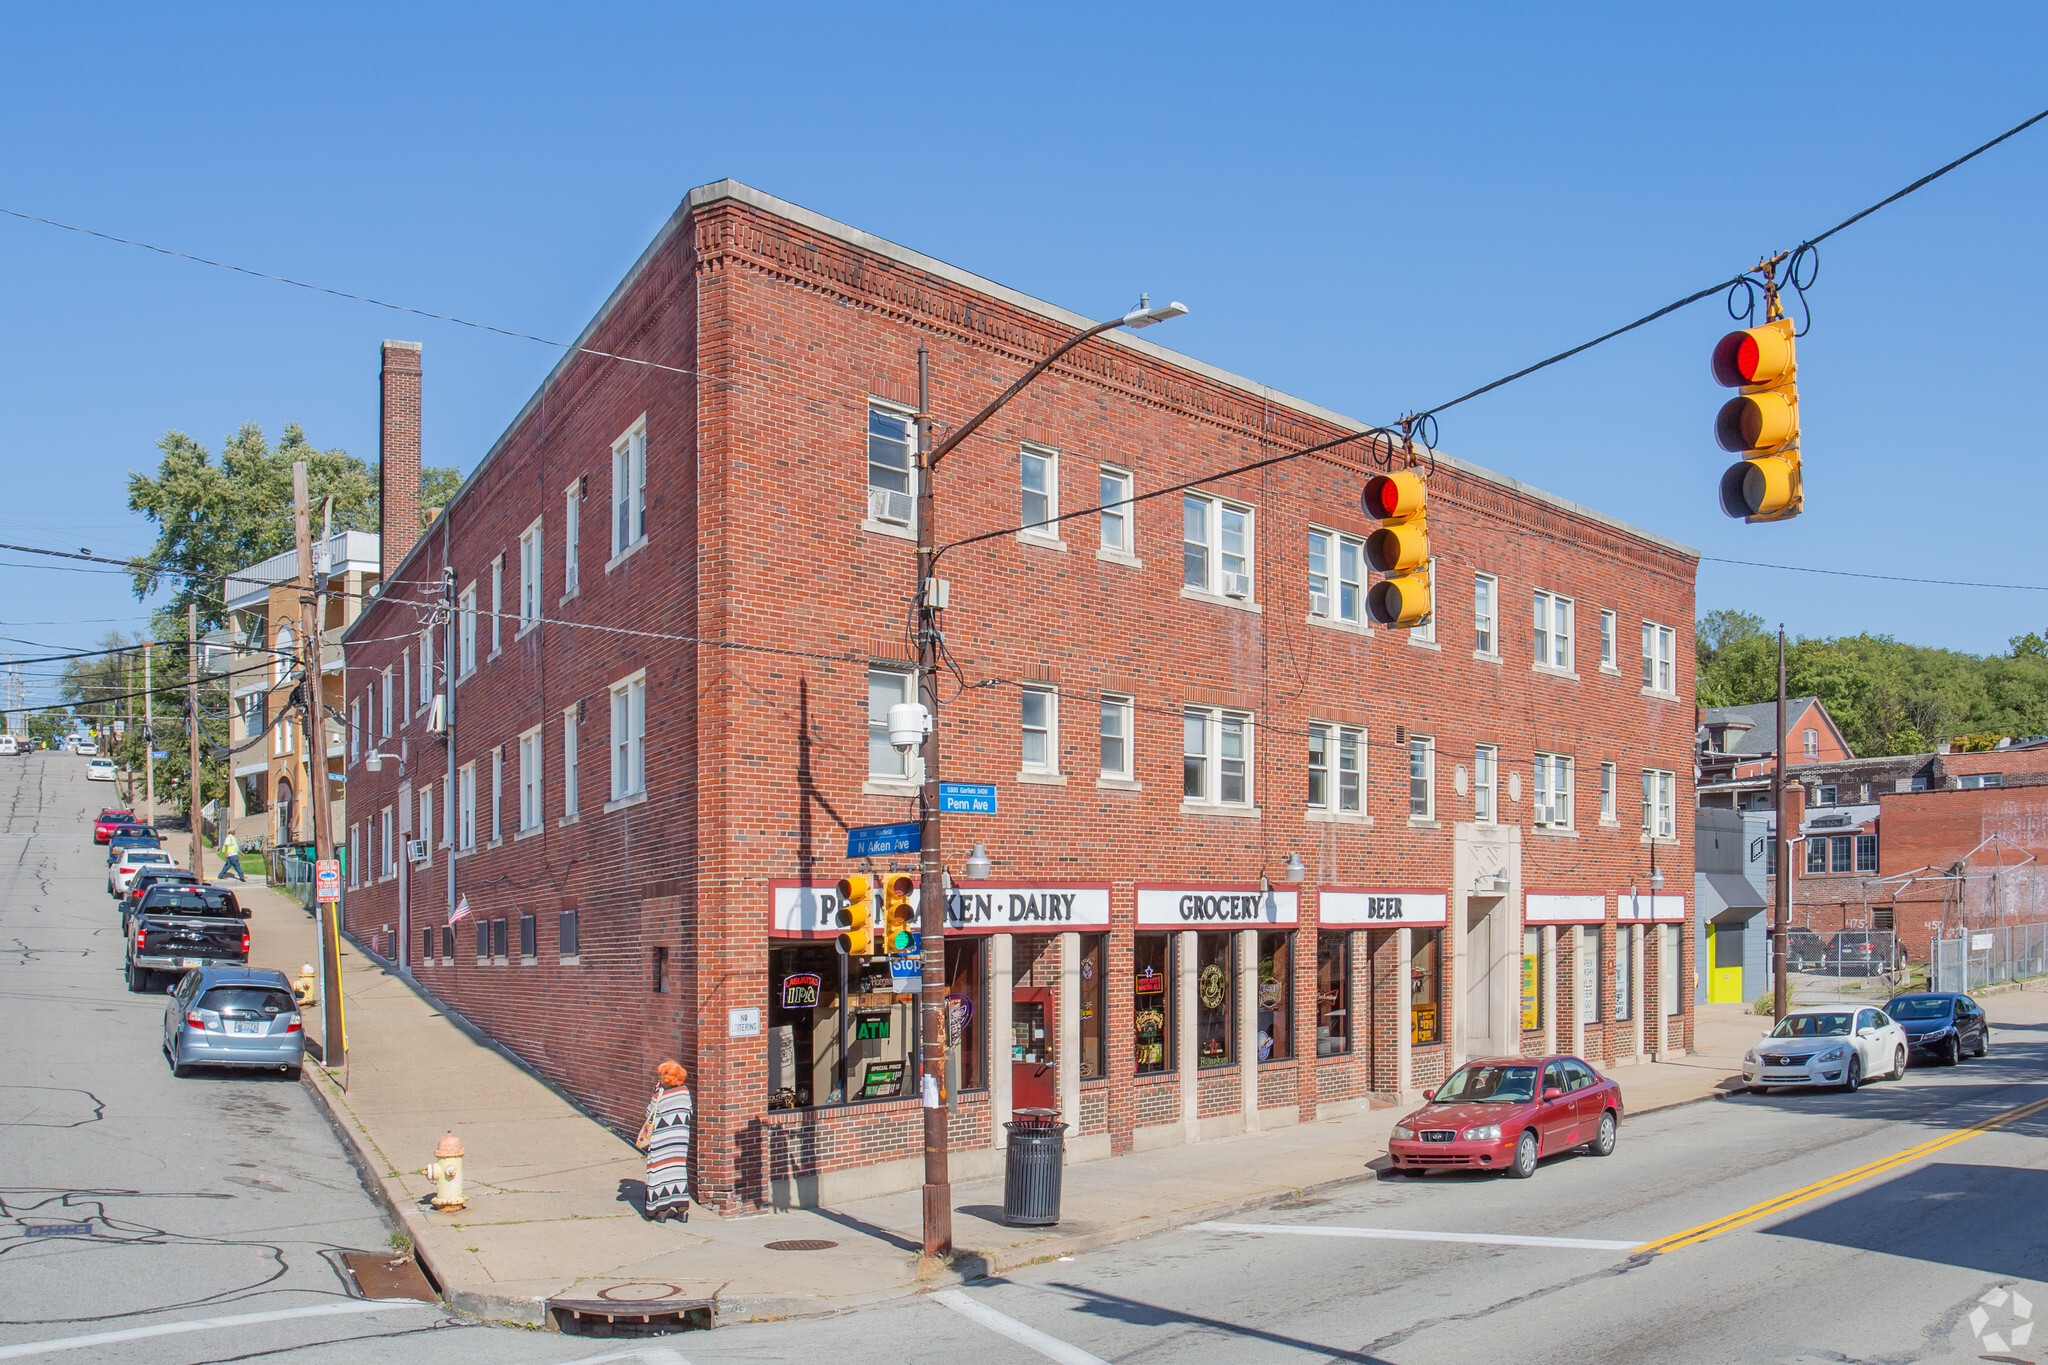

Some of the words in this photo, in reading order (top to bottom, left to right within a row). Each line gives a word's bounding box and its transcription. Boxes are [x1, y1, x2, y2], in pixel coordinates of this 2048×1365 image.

[947, 797, 970, 810] Penn
[972, 798, 989, 811] Ave
[875, 828, 892, 837] Garfield
[857, 842, 865, 853] N
[867, 839, 891, 853] Aiken
[893, 838, 910, 850] Ave
[1008, 893, 1077, 922] DAIRY
[1179, 895, 1262, 920] GROCERY
[1368, 897, 1403, 920] BEER
[1845, 919, 1866, 929] 475
[1924, 920, 1944, 930] 450
[893, 958, 922, 973] Stop
[788, 985, 815, 1004] IPA
[741, 1014, 749, 1022] NO
[732, 1022, 758, 1032] LOITERING
[857, 1023, 889, 1039] ATM
